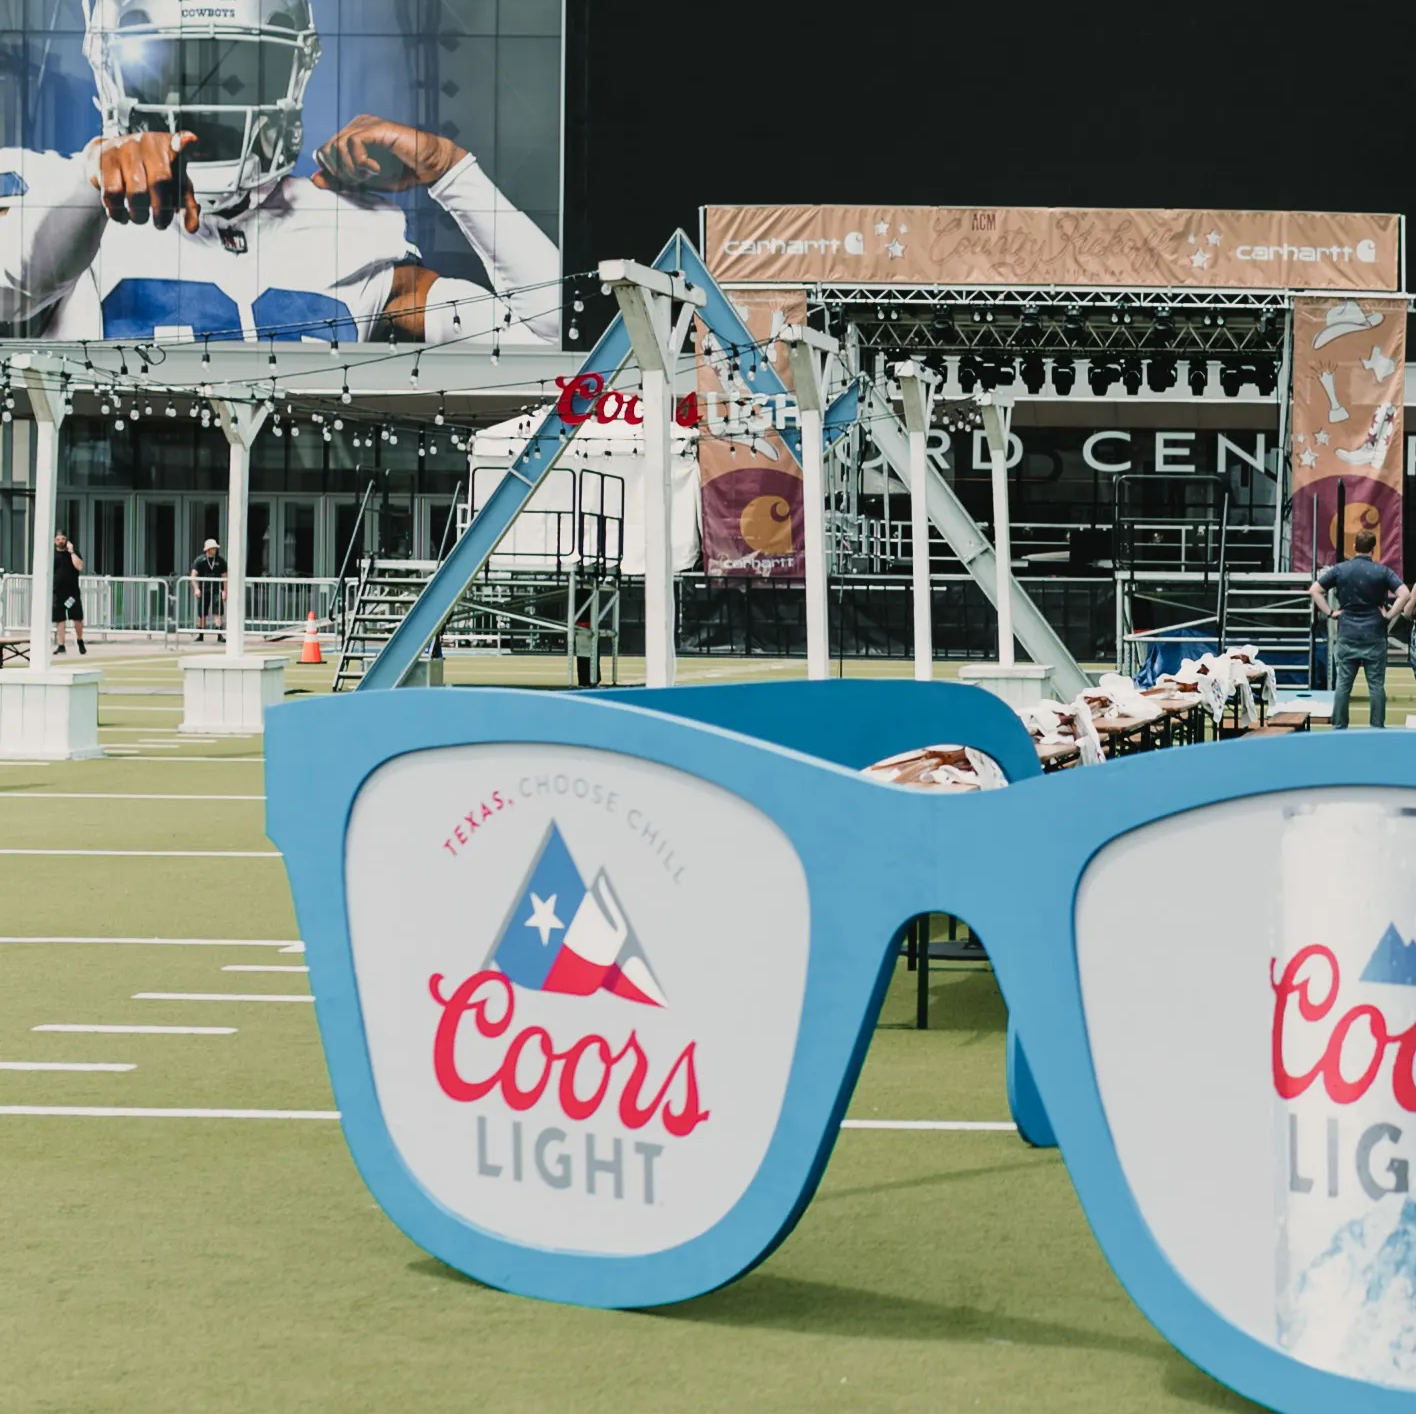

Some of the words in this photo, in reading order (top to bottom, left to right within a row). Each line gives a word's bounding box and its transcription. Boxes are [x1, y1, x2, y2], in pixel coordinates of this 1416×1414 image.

[181, 8, 236, 18] COWBOYS
[971, 213, 996, 231] ACM
[723, 237, 841, 256] carhartt
[929, 216, 1047, 277] Country
[1235, 243, 1353, 262] carhartt
[706, 391, 803, 436] LIGH
[443, 790, 515, 857] TEXAS,
[519, 774, 620, 814] CHOOSE
[627, 809, 686, 886] CHILL
[428, 969, 711, 1138] Coors
[477, 1115, 664, 1205] LIGHT
